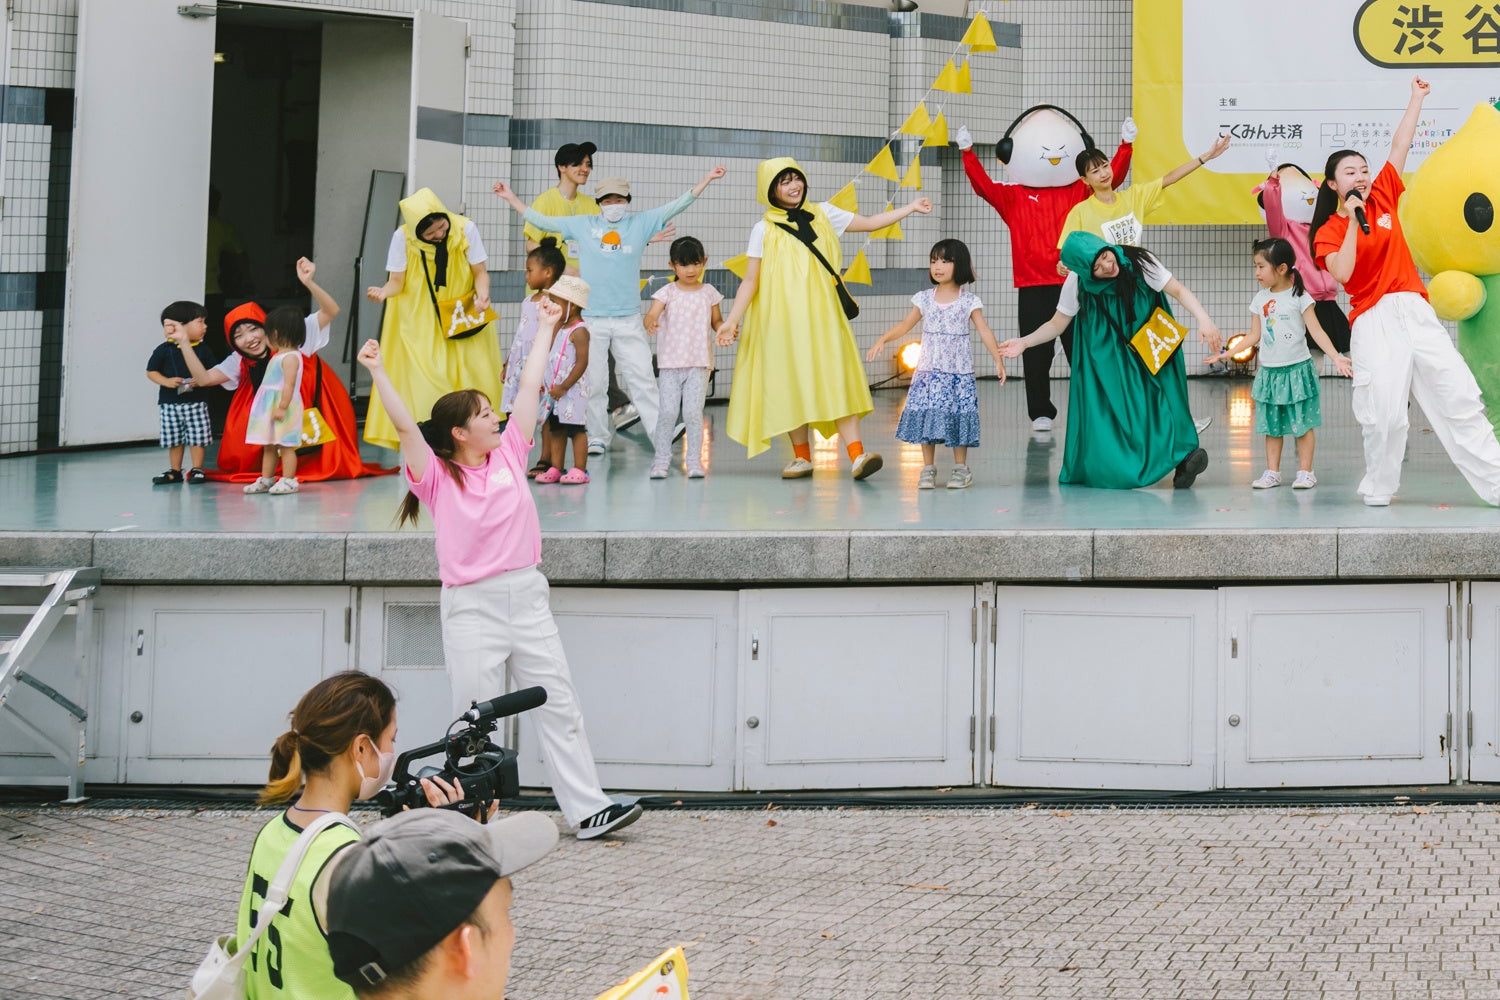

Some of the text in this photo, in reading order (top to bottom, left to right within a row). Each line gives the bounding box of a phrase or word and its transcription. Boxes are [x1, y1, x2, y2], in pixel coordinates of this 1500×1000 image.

[1219, 98, 1237, 107] 主催
[1219, 123, 1303, 140] こくみん共済
[1351, 139, 1392, 148] デザイン
[1145, 313, 1181, 369] AJ
[302, 410, 321, 445] J
